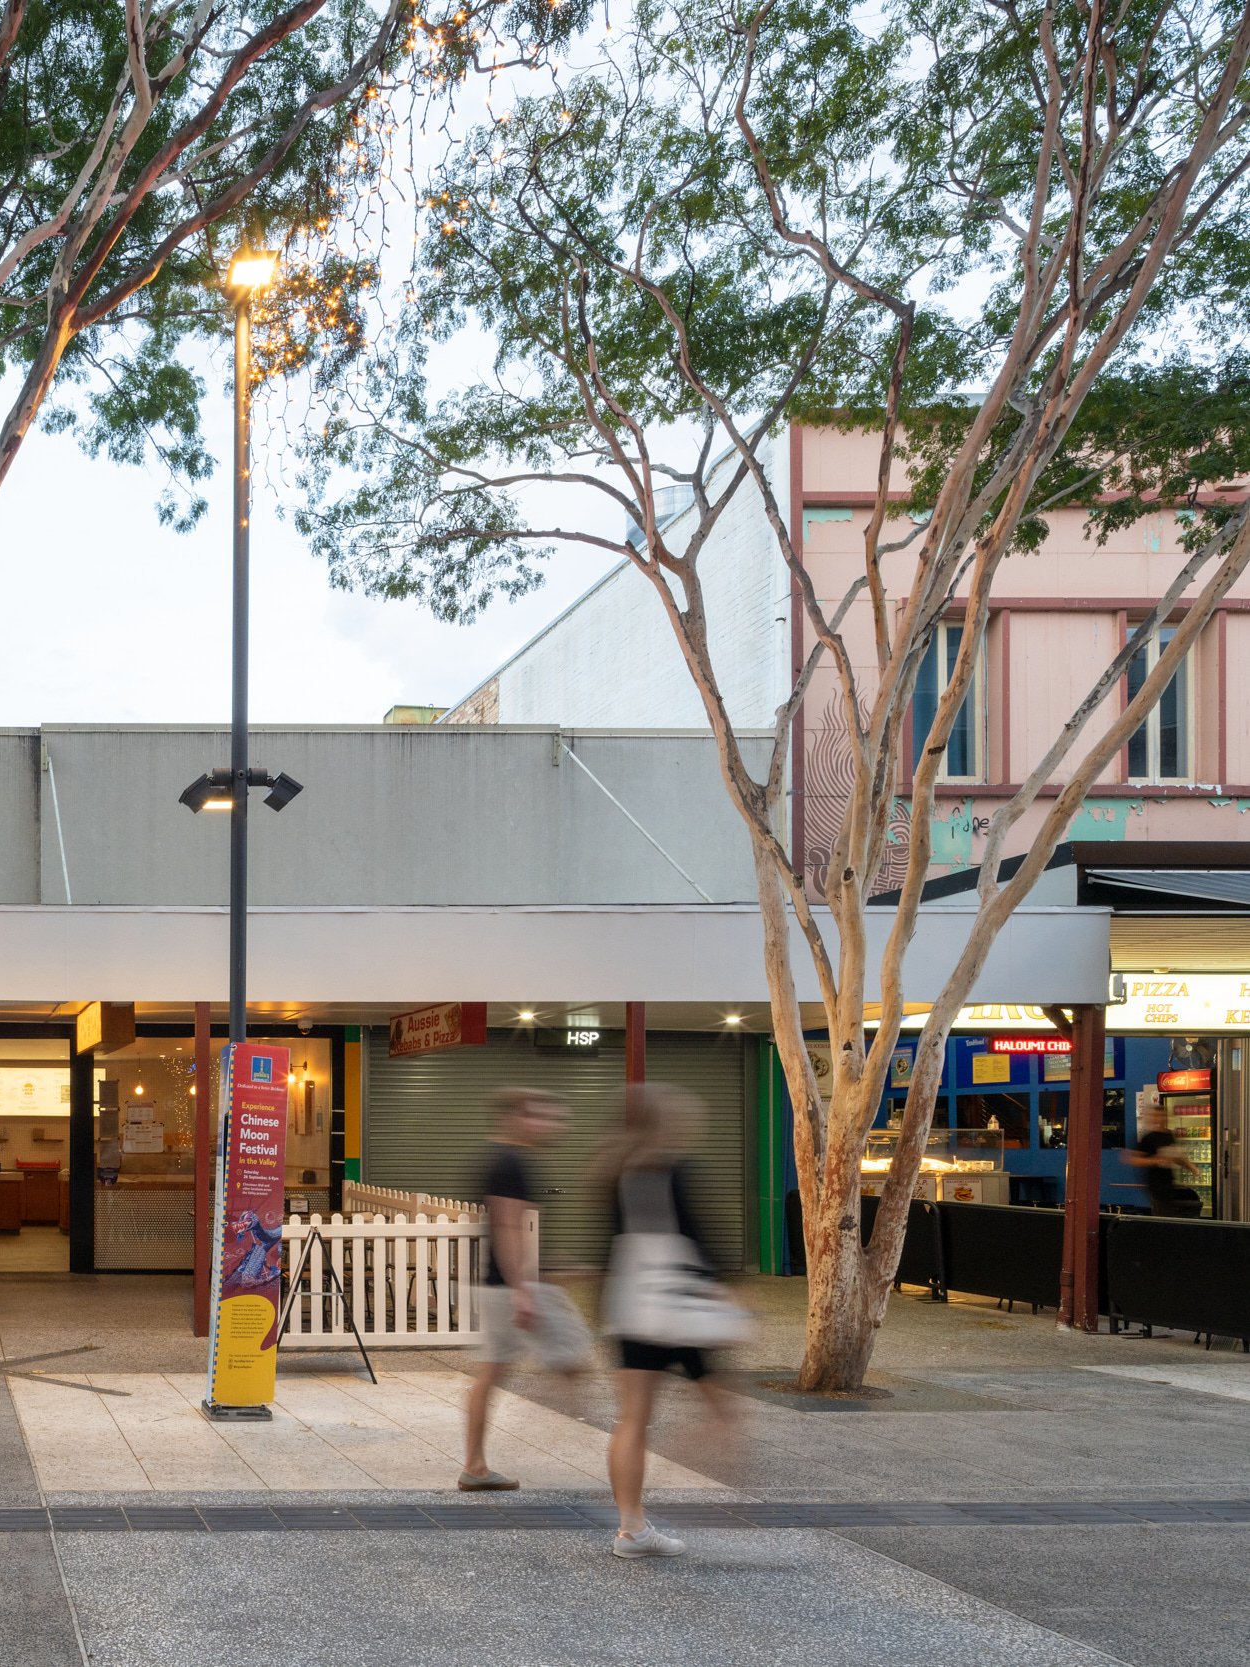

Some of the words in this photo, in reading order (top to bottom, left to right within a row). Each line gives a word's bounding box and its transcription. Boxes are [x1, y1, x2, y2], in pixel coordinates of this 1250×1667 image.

[1131, 982, 1190, 997] PIZZA
[1146, 1003, 1173, 1013] HOT
[407, 1010, 440, 1033] Aussie
[1144, 1013, 1179, 1023] CHIPS
[424, 1033, 431, 1047] &
[433, 1030, 455, 1045] Pizza
[567, 1031, 600, 1045] HSP
[994, 1040, 1046, 1051] HALOUMI
[241, 1101, 275, 1112] Experience
[240, 1113, 280, 1128] Chinese
[240, 1128, 270, 1141] Moon
[239, 1142, 278, 1156] Festival
[258, 1158, 277, 1168] Valley
